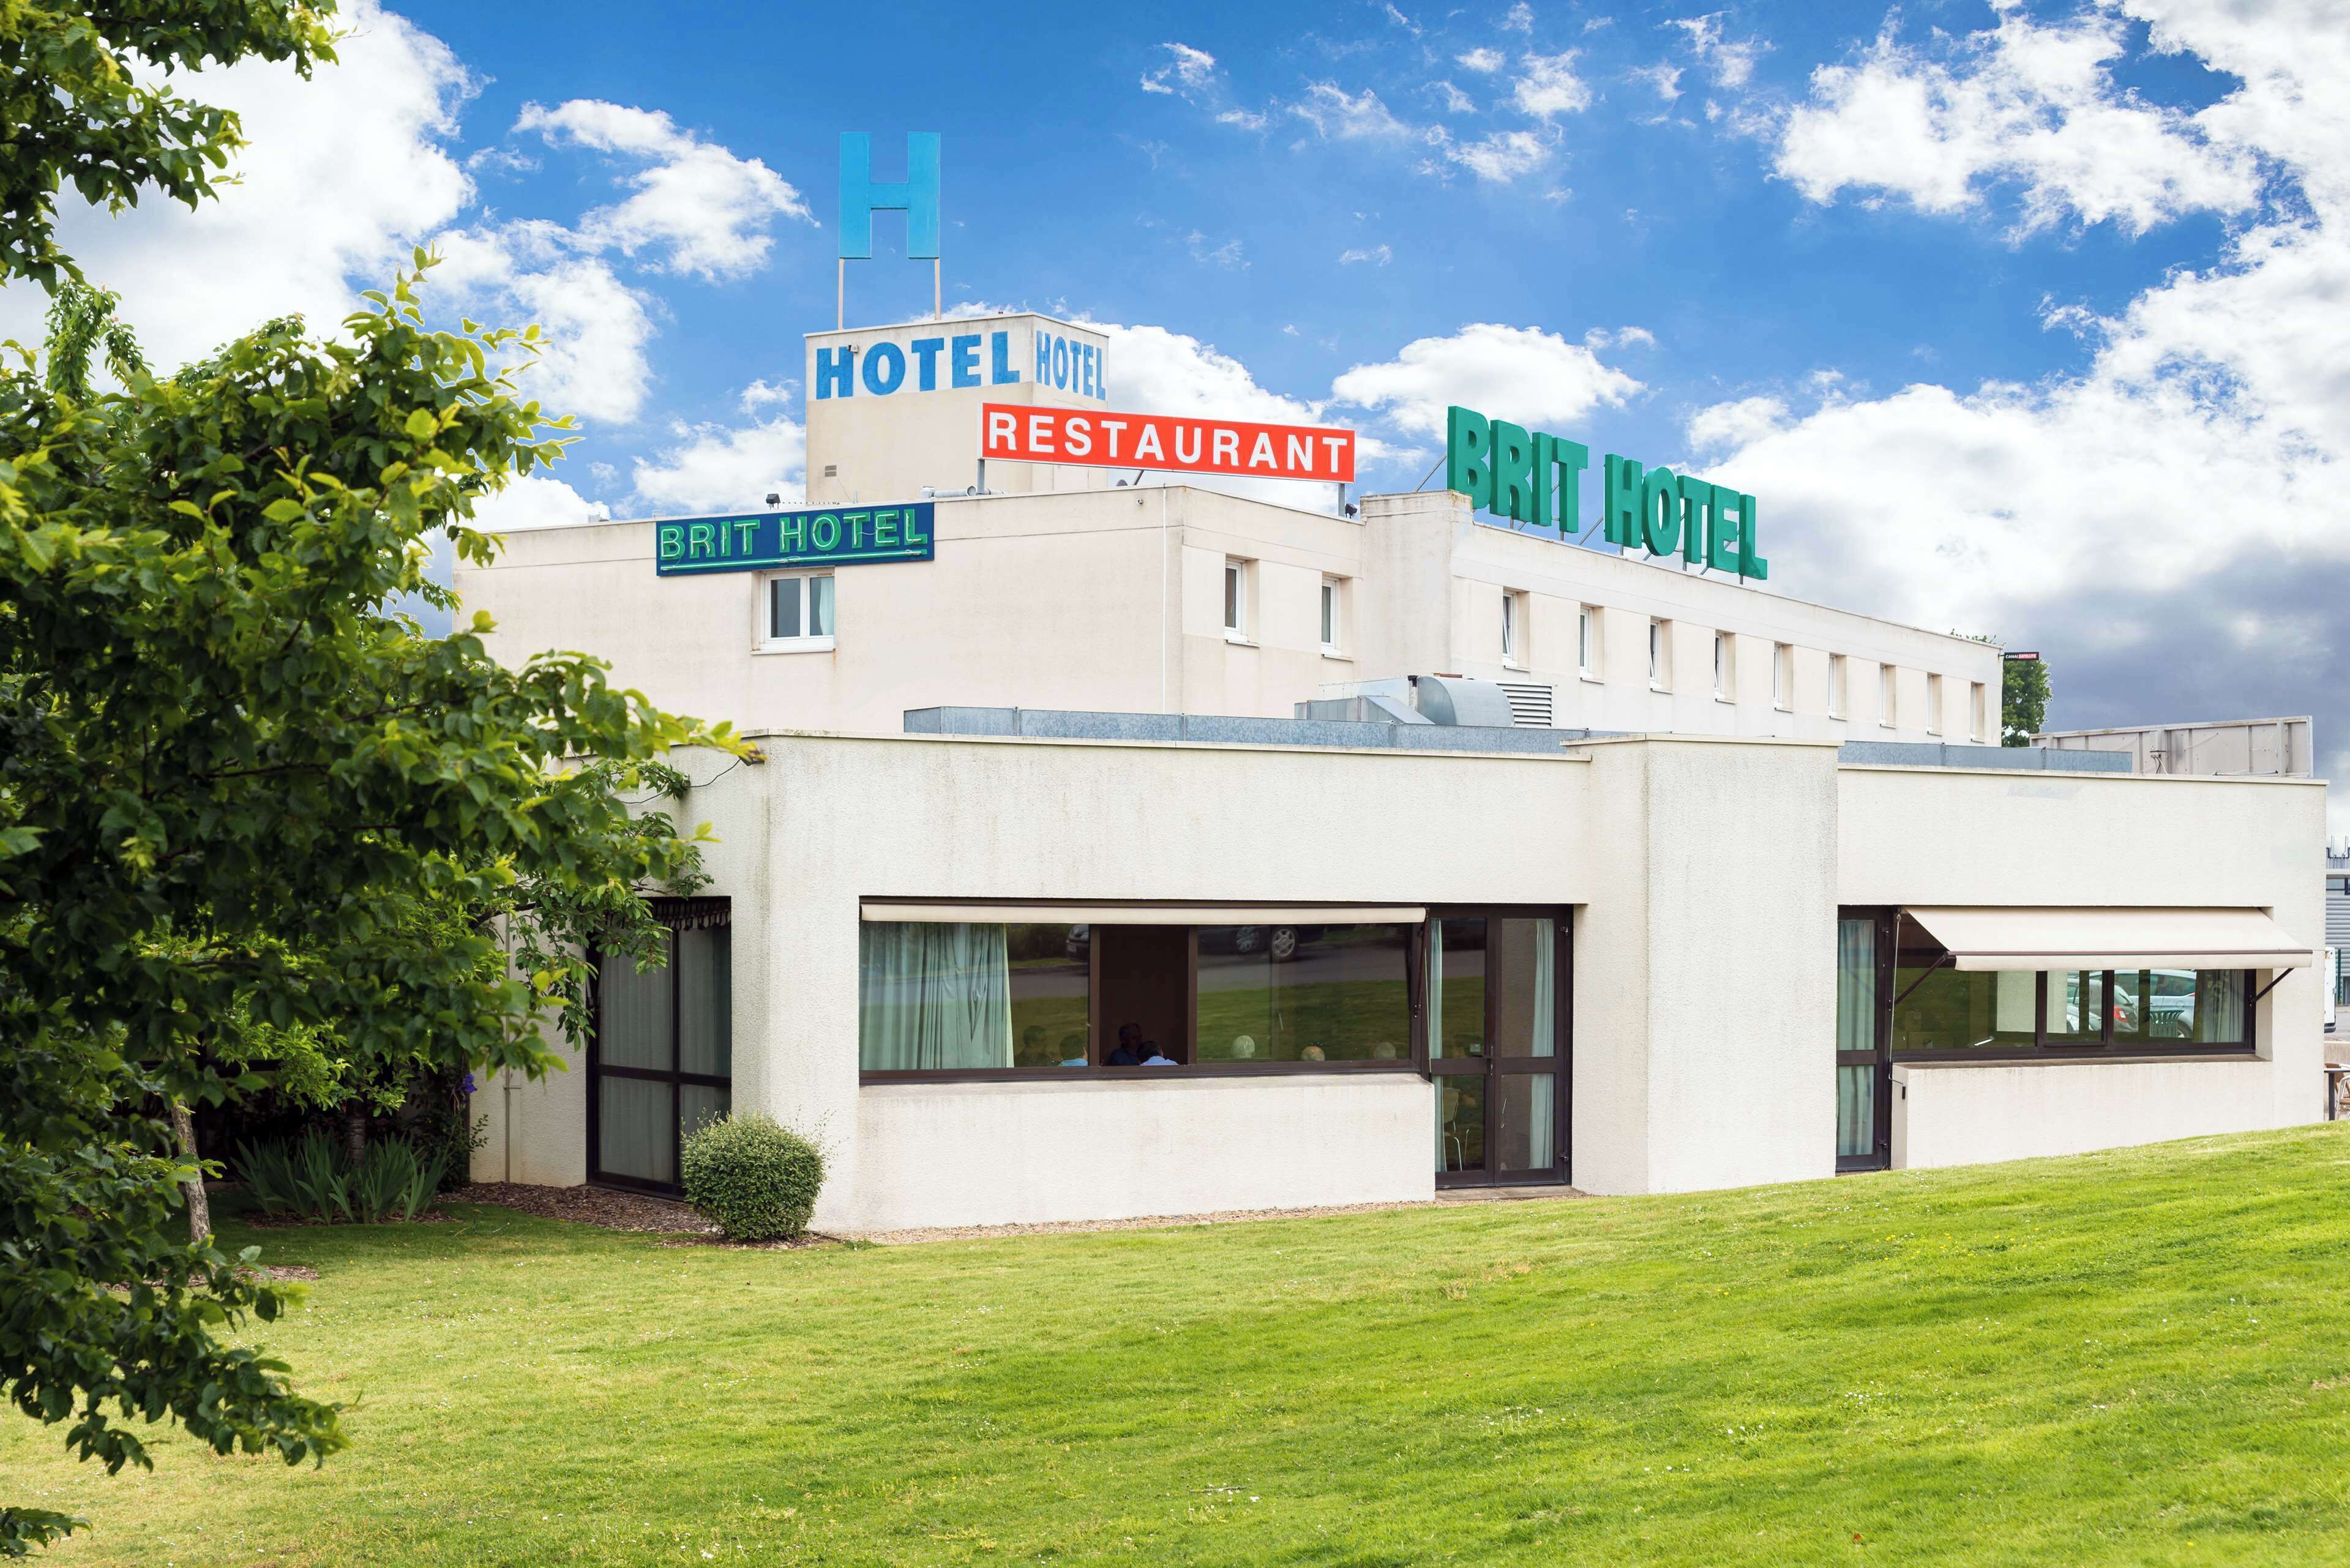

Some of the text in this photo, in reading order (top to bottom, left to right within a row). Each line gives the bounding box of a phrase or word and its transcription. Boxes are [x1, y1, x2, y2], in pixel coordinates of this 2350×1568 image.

[839, 132, 940, 259] H
[815, 331, 1020, 400] HOTEL
[1036, 330, 1106, 400] HOTEL
[989, 412, 1347, 473] RESTAURANT
[1447, 406, 1768, 580] BRIT HOTEL
[660, 509, 928, 561] BRIT HOTEL
